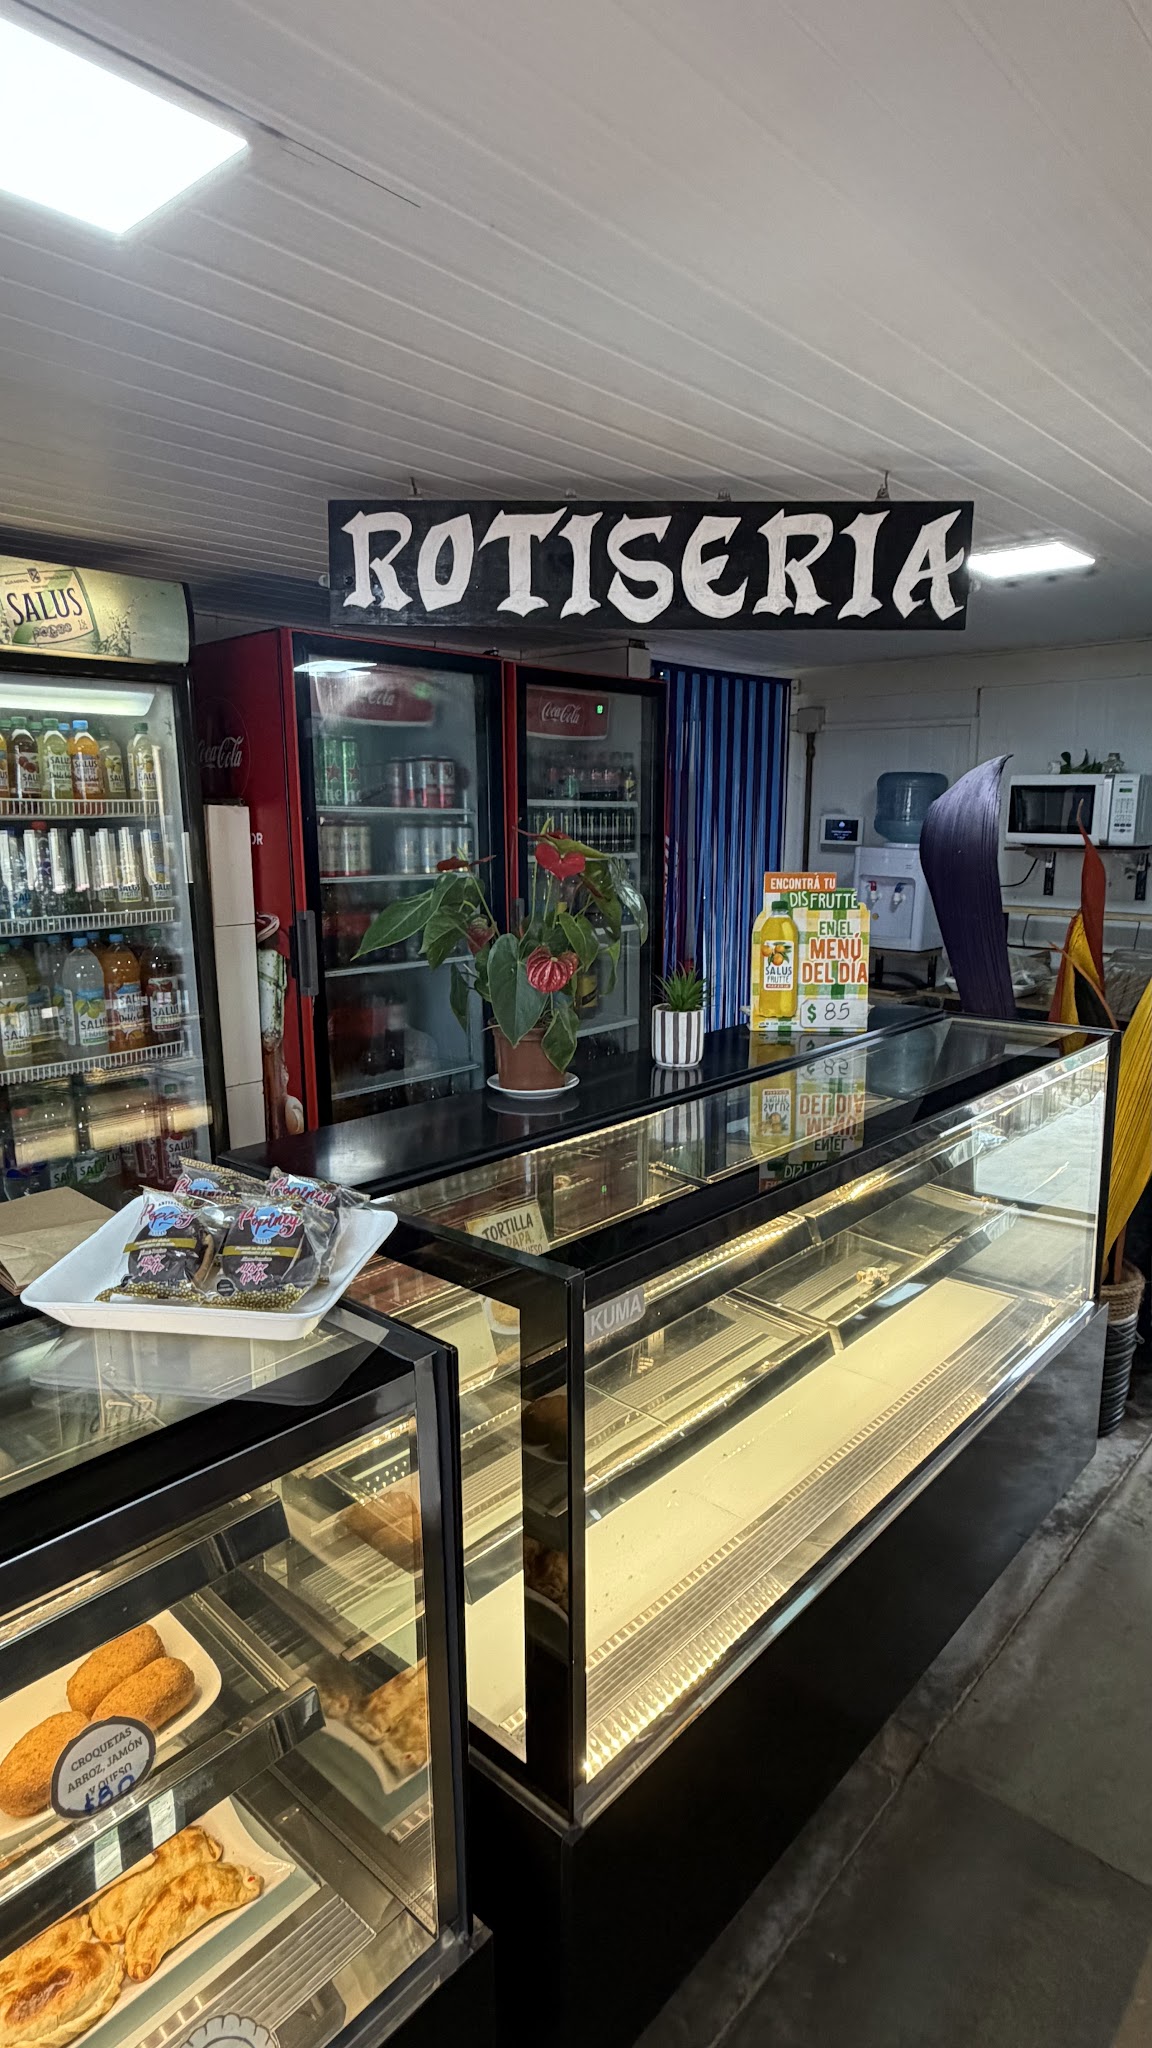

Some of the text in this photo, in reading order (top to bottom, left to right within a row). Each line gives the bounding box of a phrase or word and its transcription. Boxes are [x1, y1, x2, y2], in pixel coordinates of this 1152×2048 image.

[342, 506, 966, 623] ROTISERIA
[6, 587, 83, 626] SALUS
[770, 873, 837, 890] ENCONTRÁ TU
[819, 921, 854, 936] EN EL
[810, 932, 863, 961] MENÚ
[765, 966, 792, 976] SALUS
[801, 956, 869, 984] DEL DÍA
[806, 1002, 851, 1024] $ 85
[481, 1212, 534, 1241] TORTILLA
[590, 1294, 643, 1336] KUMA
[71, 1727, 133, 1772] CROQUETAS
[67, 1736, 144, 1794] ARROZ, JAMÓN
